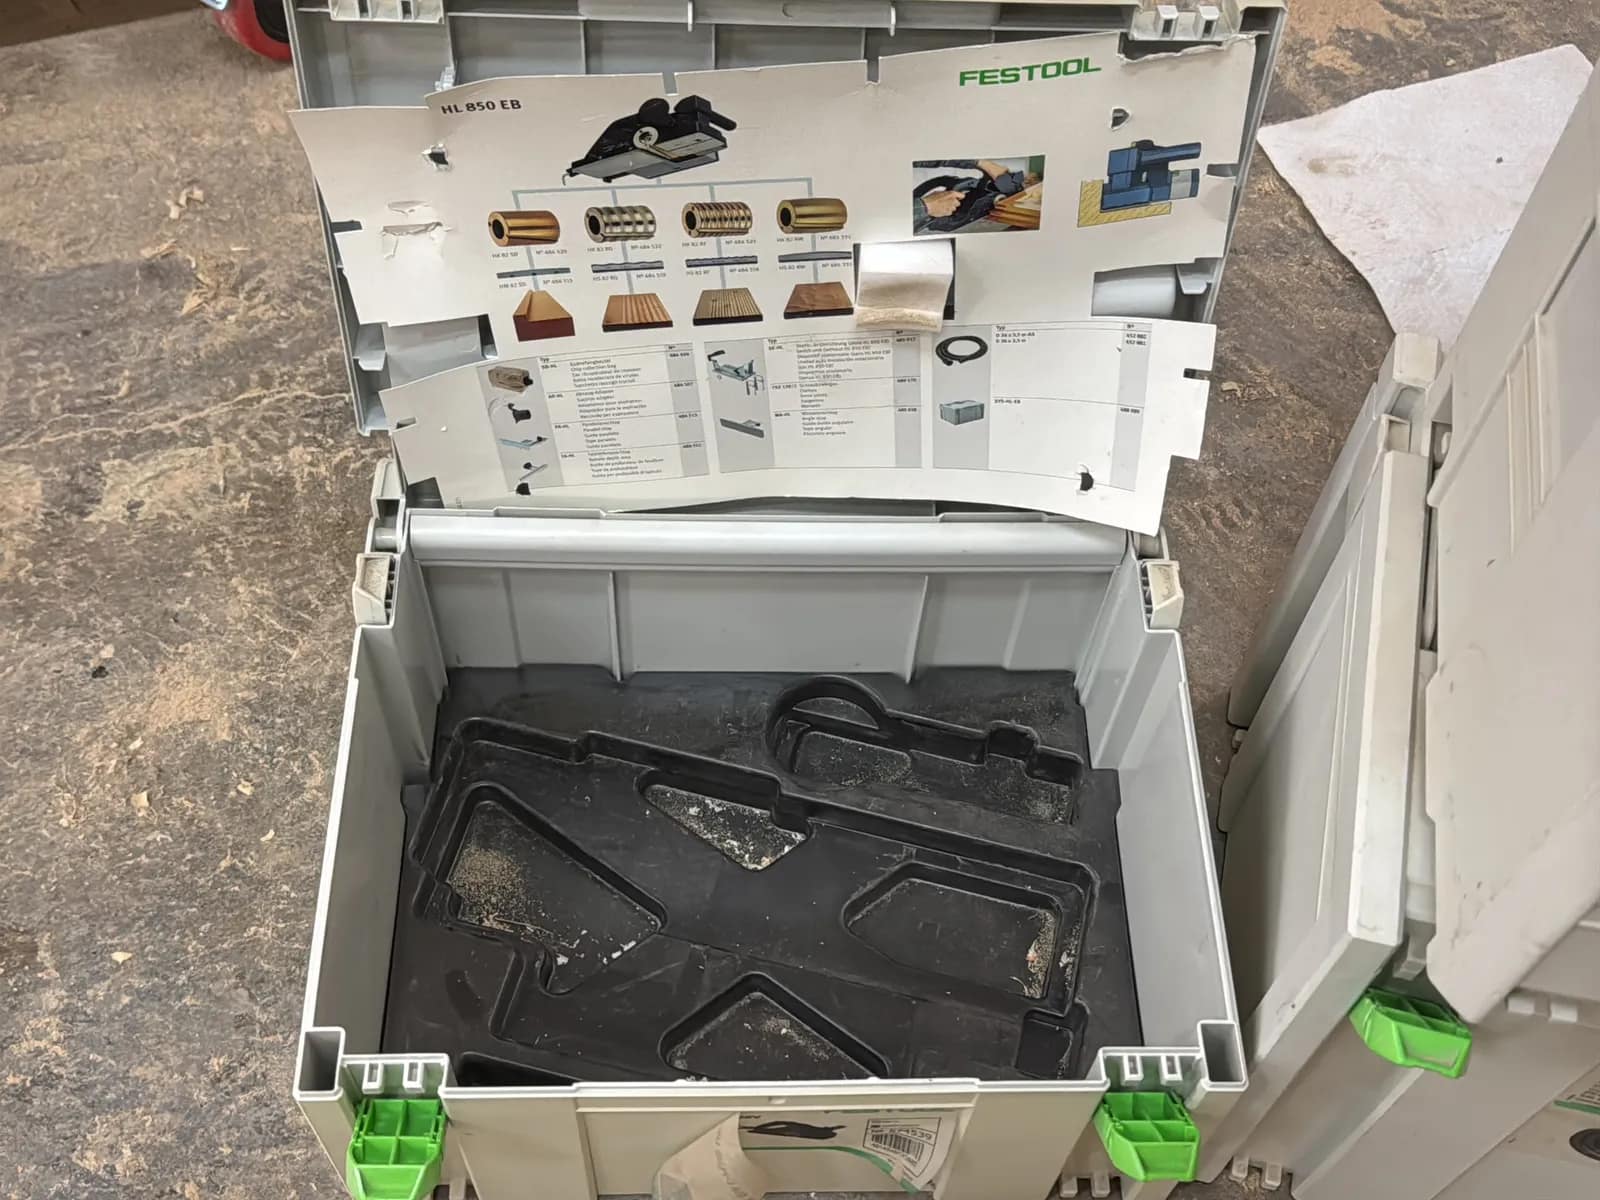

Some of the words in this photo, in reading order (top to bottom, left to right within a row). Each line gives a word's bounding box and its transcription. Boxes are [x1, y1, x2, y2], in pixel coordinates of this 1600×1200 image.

[959, 57, 1102, 87] FESTOOL
[441, 104, 464, 114] HL
[465, 100, 496, 112] 850
[500, 99, 522, 110] EB
